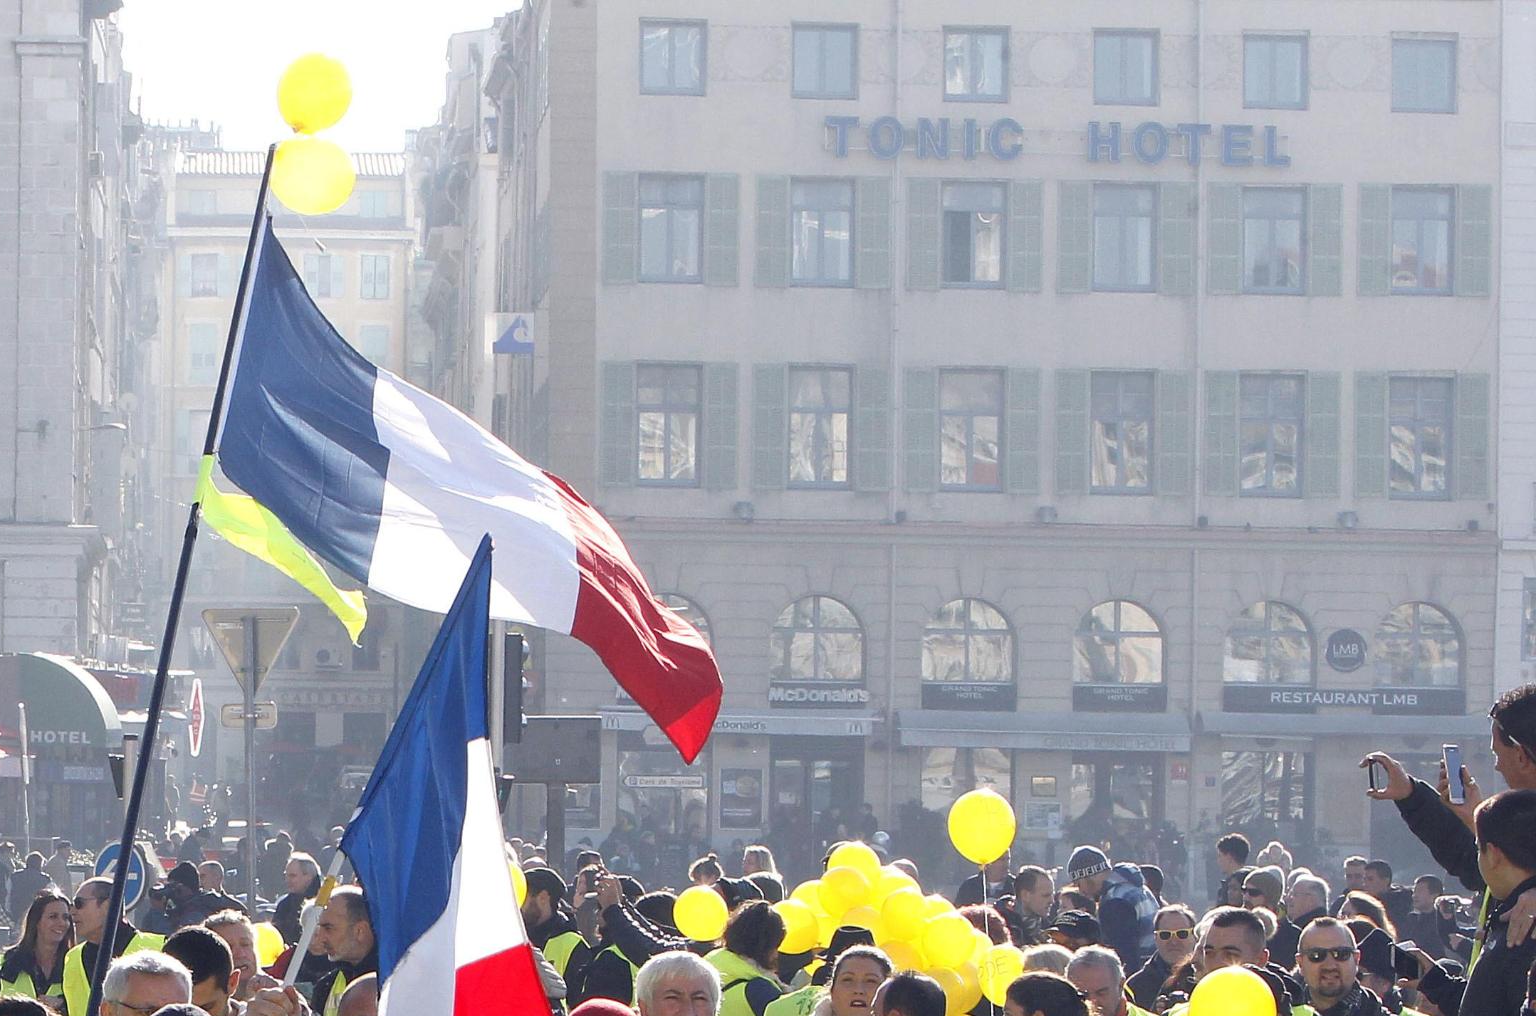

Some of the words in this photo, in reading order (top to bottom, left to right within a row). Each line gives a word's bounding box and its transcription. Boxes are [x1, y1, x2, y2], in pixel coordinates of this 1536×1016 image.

[825, 116, 1024, 162] TONIC
[1086, 120, 1291, 167] HOTEL
[1332, 643, 1359, 656] LMB
[768, 687, 870, 703] McDonald's
[1270, 691, 1379, 705] RESTAURANT
[1382, 694, 1418, 706] LMB
[714, 720, 767, 731] cDonald's
[30, 730, 91, 745] HOTEL
